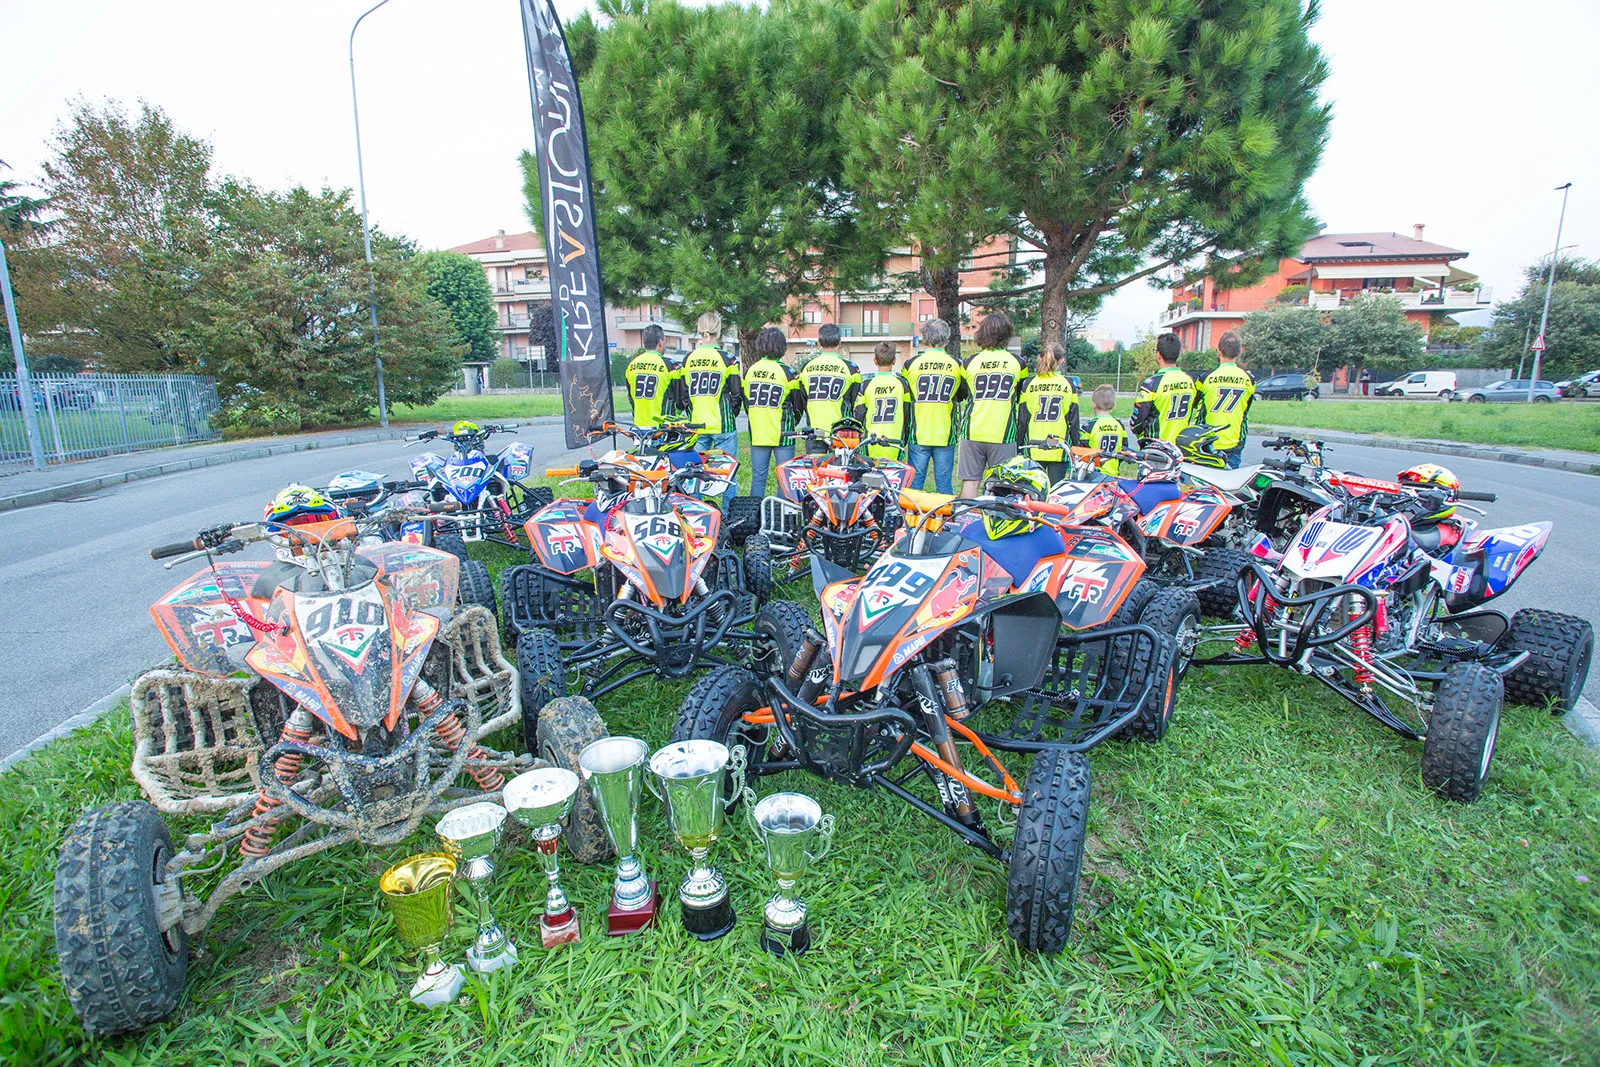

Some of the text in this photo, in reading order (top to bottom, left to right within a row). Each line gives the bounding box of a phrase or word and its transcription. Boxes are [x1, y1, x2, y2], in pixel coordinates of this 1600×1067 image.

[753, 371, 769, 379] NESI
[918, 362, 944, 371] ASTORI
[980, 361, 1000, 369] NESI
[689, 371, 722, 396] 200
[807, 375, 846, 402] 250
[874, 386, 895, 395] RIKY
[916, 374, 956, 403] 910
[973, 373, 1014, 401] 999
[1208, 375, 1244, 384] CARMINATI
[748, 381, 784, 409] 568
[1210, 387, 1246, 412] 77
[871, 397, 898, 424] 12
[1034, 395, 1064, 422] 16
[451, 466, 485, 481] 200
[1345, 475, 1396, 490] HONDA
[634, 516, 681, 543] 568
[548, 534, 576, 556] FTR
[861, 561, 936, 599] 999
[1068, 575, 1107, 603] FTR
[305, 597, 385, 640] 910
[902, 635, 927, 658] MAPEI
